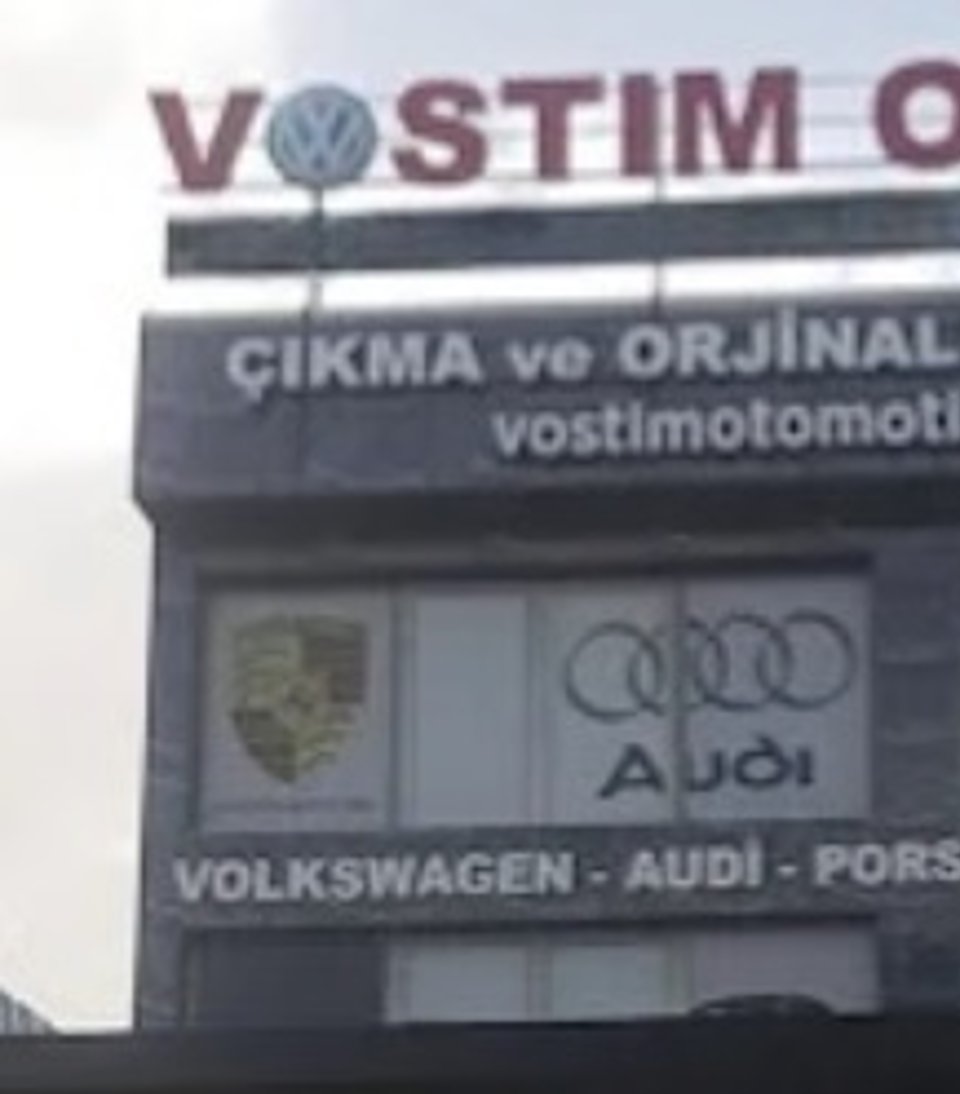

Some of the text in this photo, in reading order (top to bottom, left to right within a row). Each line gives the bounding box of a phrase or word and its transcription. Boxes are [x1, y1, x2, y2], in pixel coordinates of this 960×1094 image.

[224, 329, 485, 401] ÇIKMA
[505, 335, 594, 382] ve
[173, 851, 574, 902] VOLKSWAGEN
